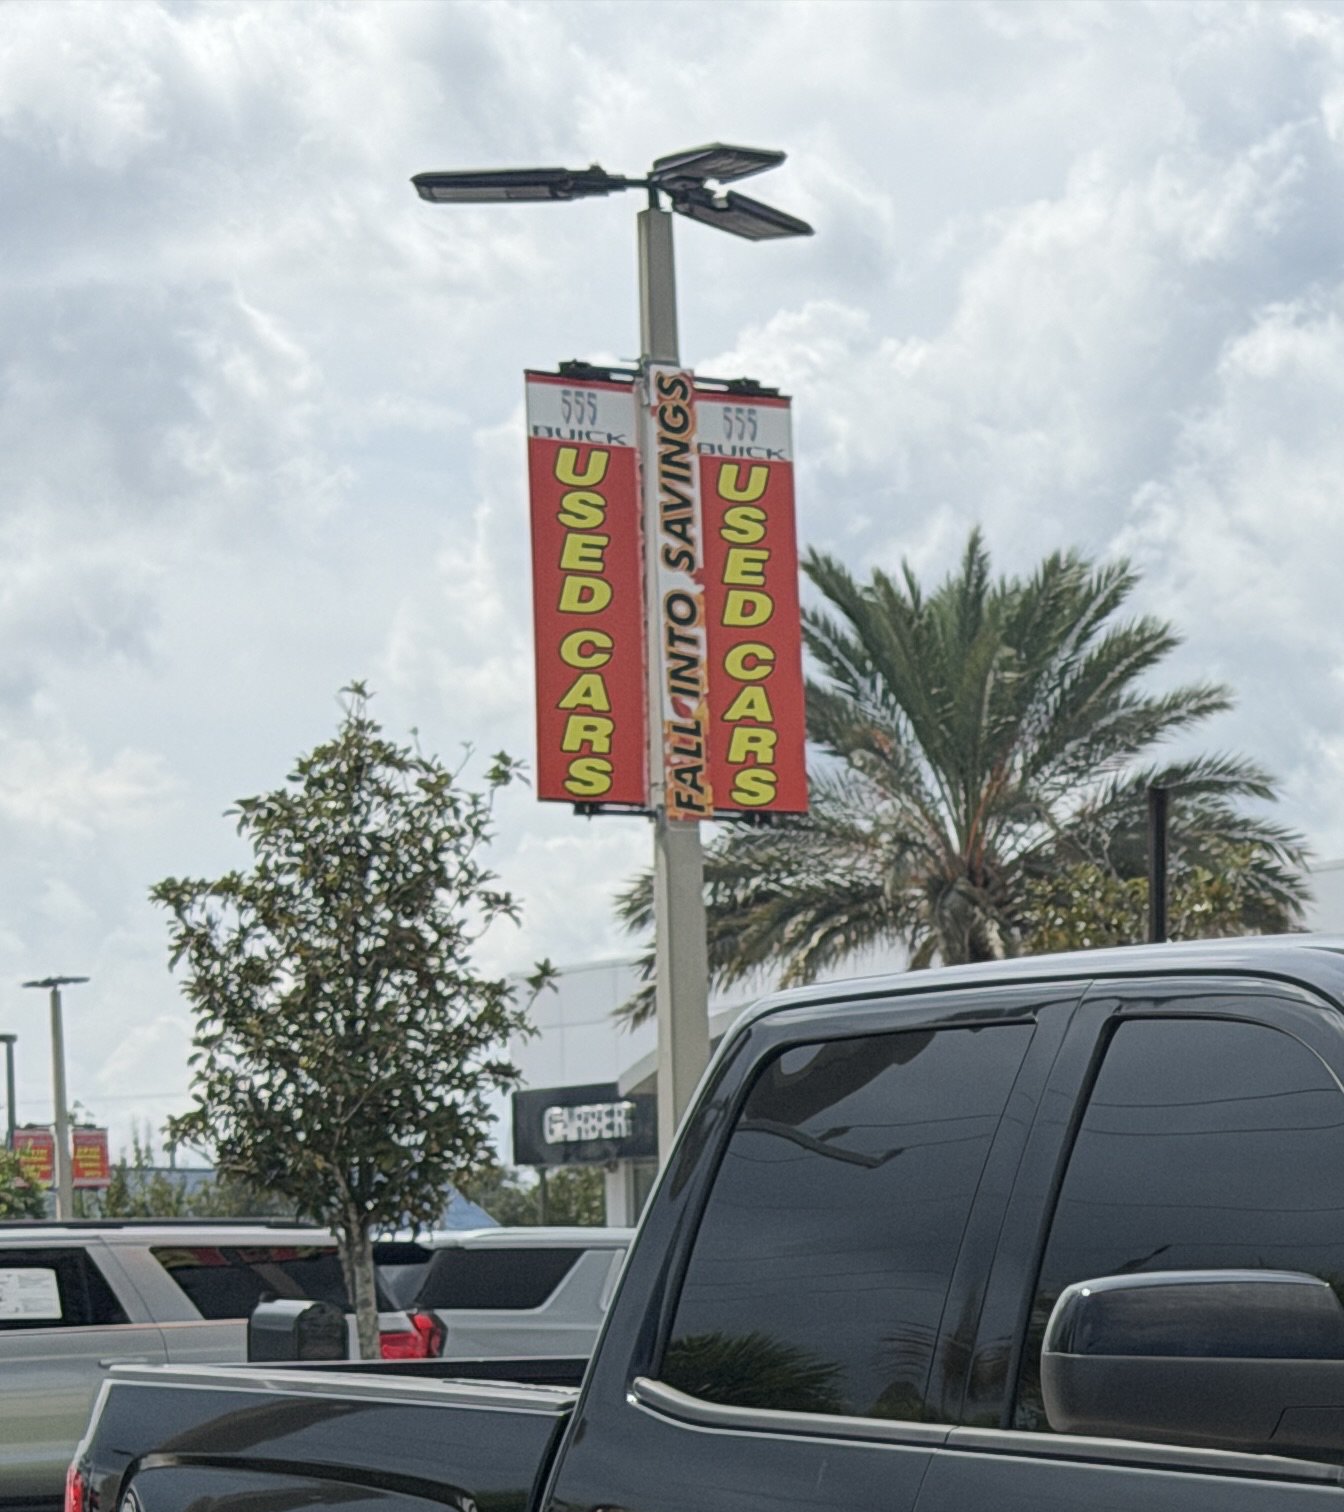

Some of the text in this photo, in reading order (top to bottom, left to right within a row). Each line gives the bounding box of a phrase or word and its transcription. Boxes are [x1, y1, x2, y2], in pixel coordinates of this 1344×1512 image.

[553, 447, 616, 798] USED CARS
[656, 373, 706, 813] FALL INTO SAVINGS
[716, 463, 780, 809] USED CARS
